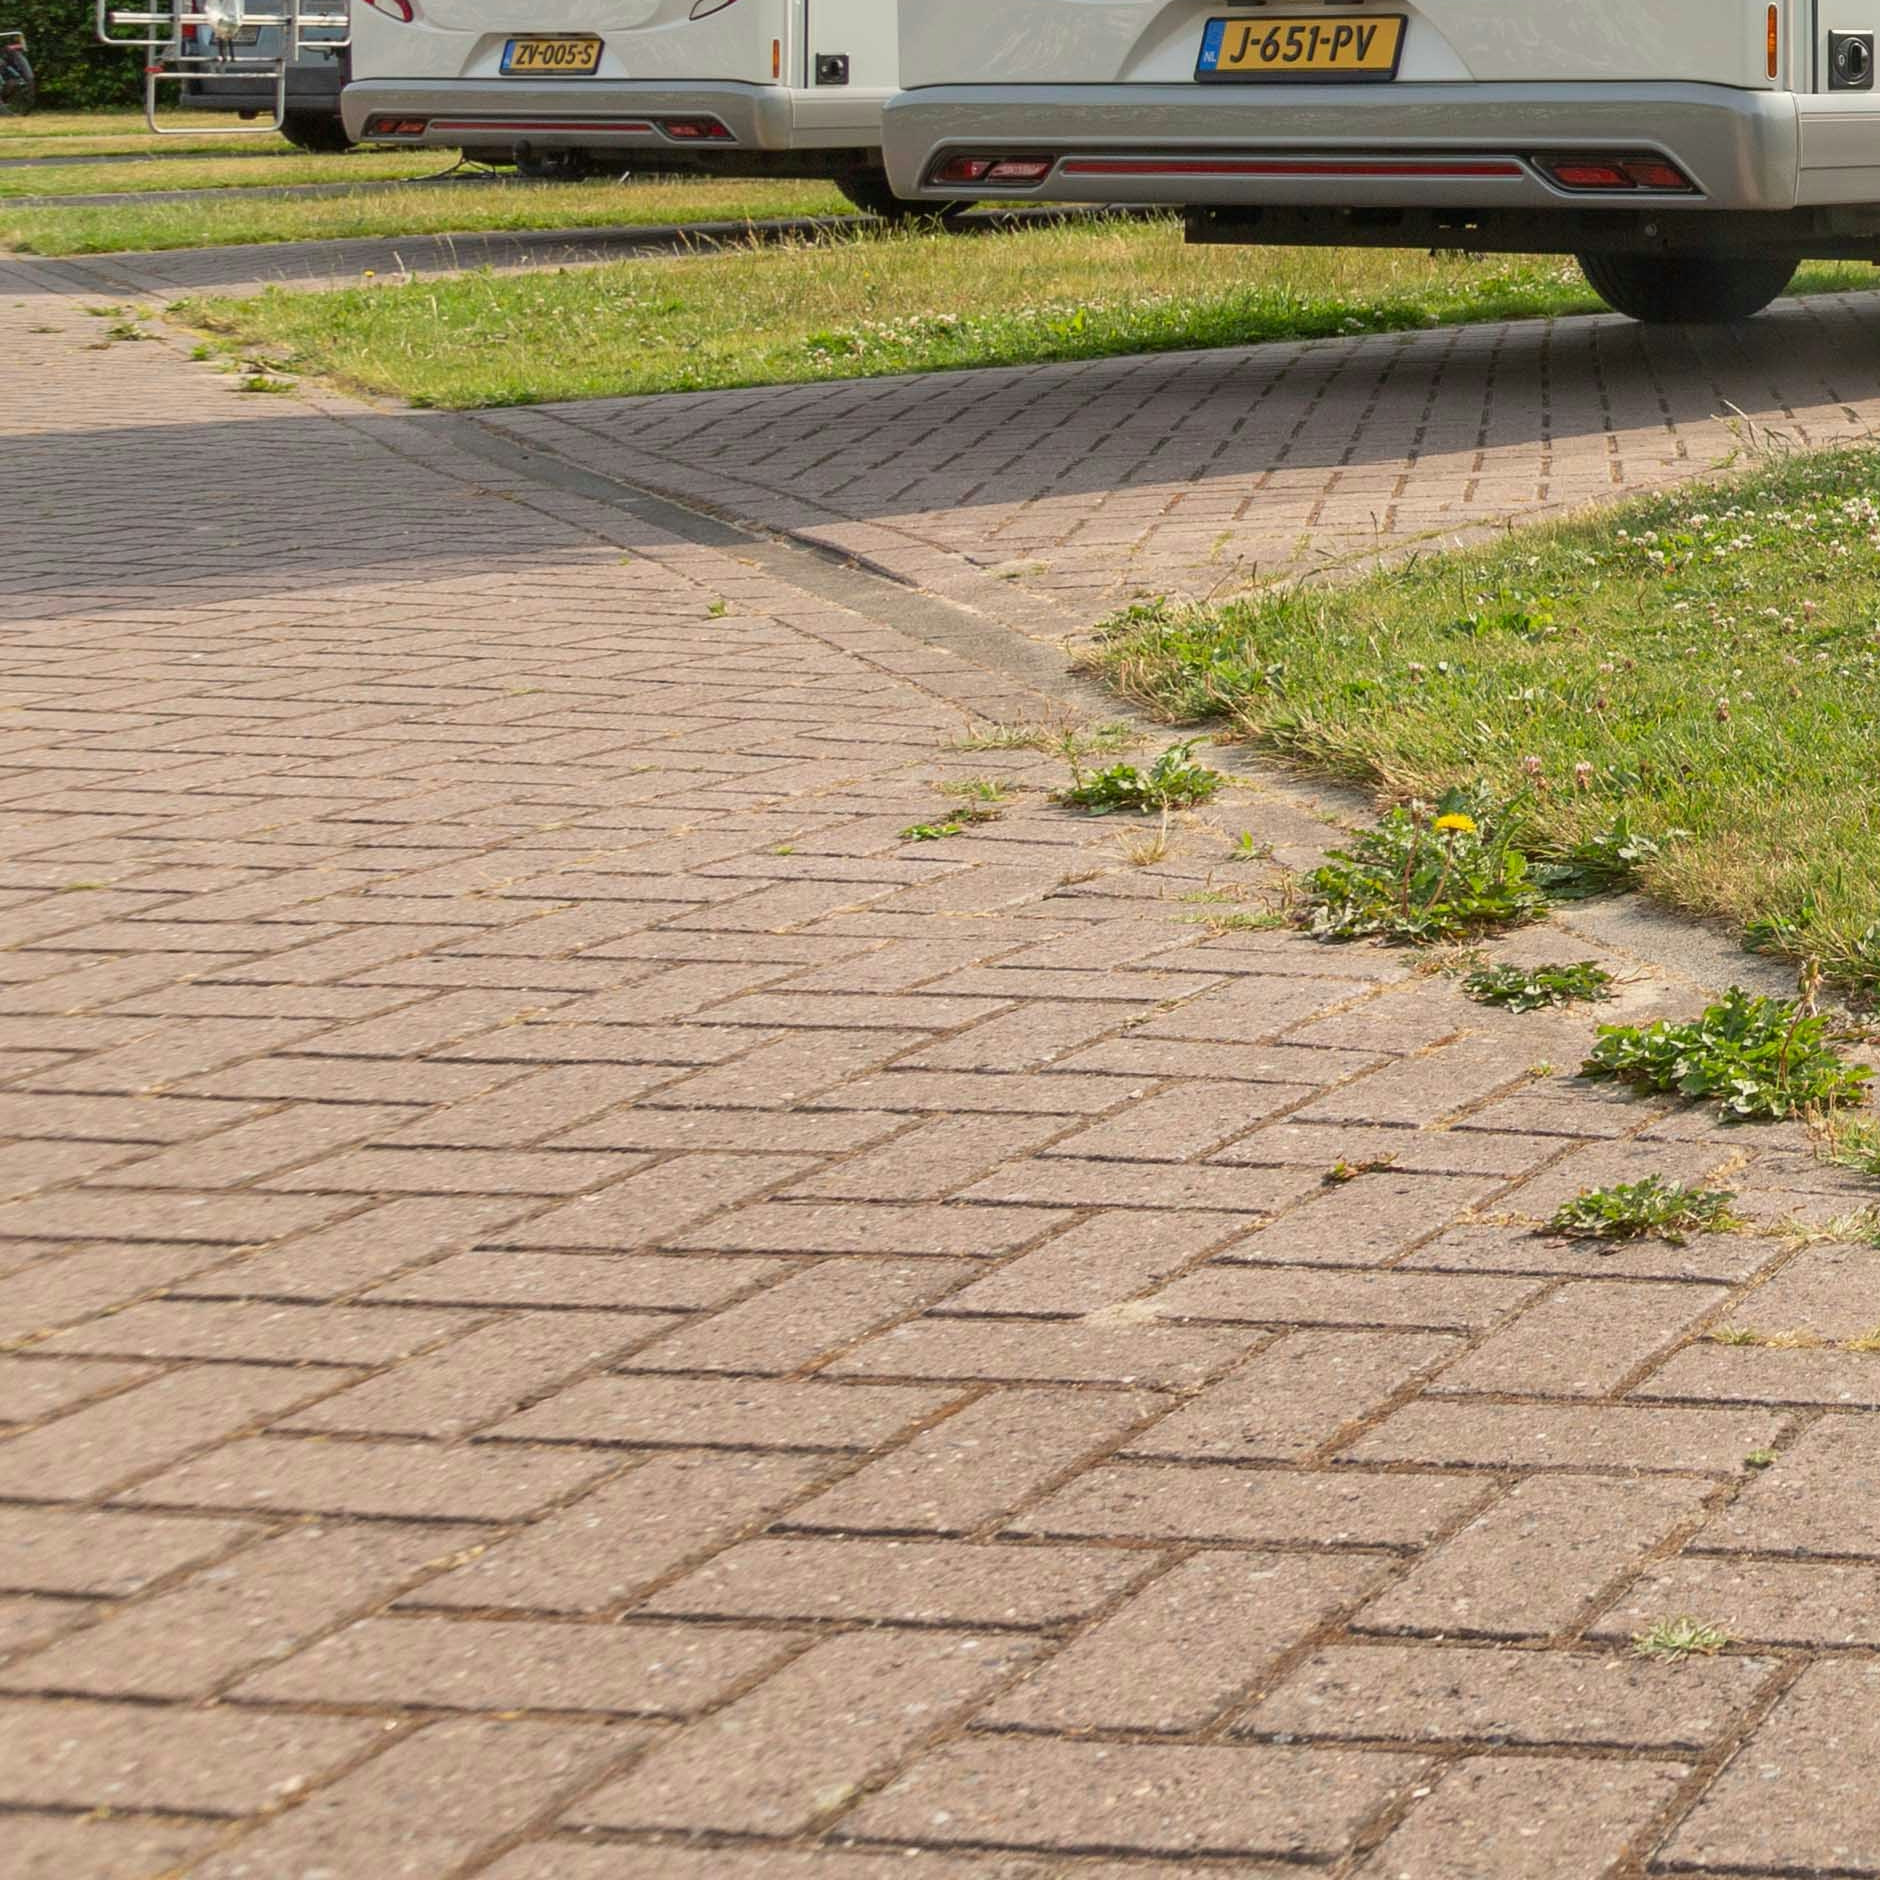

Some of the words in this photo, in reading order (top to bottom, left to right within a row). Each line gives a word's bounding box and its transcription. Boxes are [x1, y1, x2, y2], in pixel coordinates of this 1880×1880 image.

[515, 43, 595, 66] ZV-005-S
[1229, 24, 1378, 64] J-651-PV
[1203, 51, 1217, 63] NL
